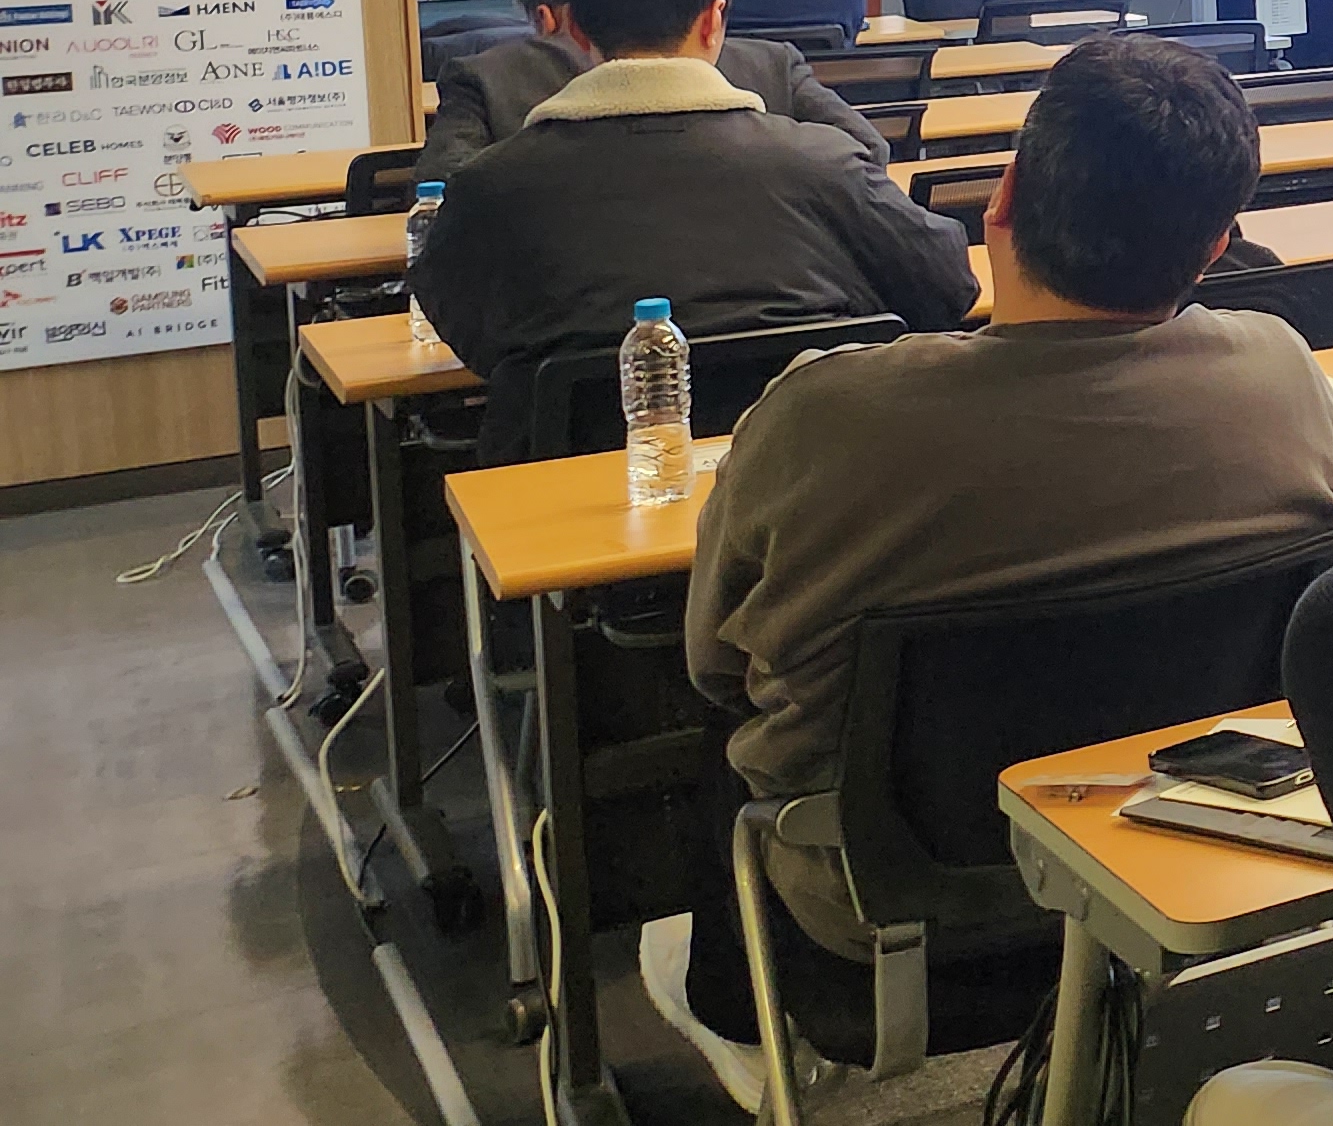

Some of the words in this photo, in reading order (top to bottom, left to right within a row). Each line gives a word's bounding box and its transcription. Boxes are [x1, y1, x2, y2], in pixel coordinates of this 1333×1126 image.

[112, 104, 173, 117] TAEWON
[26, 139, 97, 157] CELEB
[101, 140, 144, 150] HOMES
[62, 167, 129, 188] CLIFF
[65, 195, 126, 213] SEBO
[118, 225, 183, 244] XPEGE
[153, 318, 219, 335] BRIDGE
